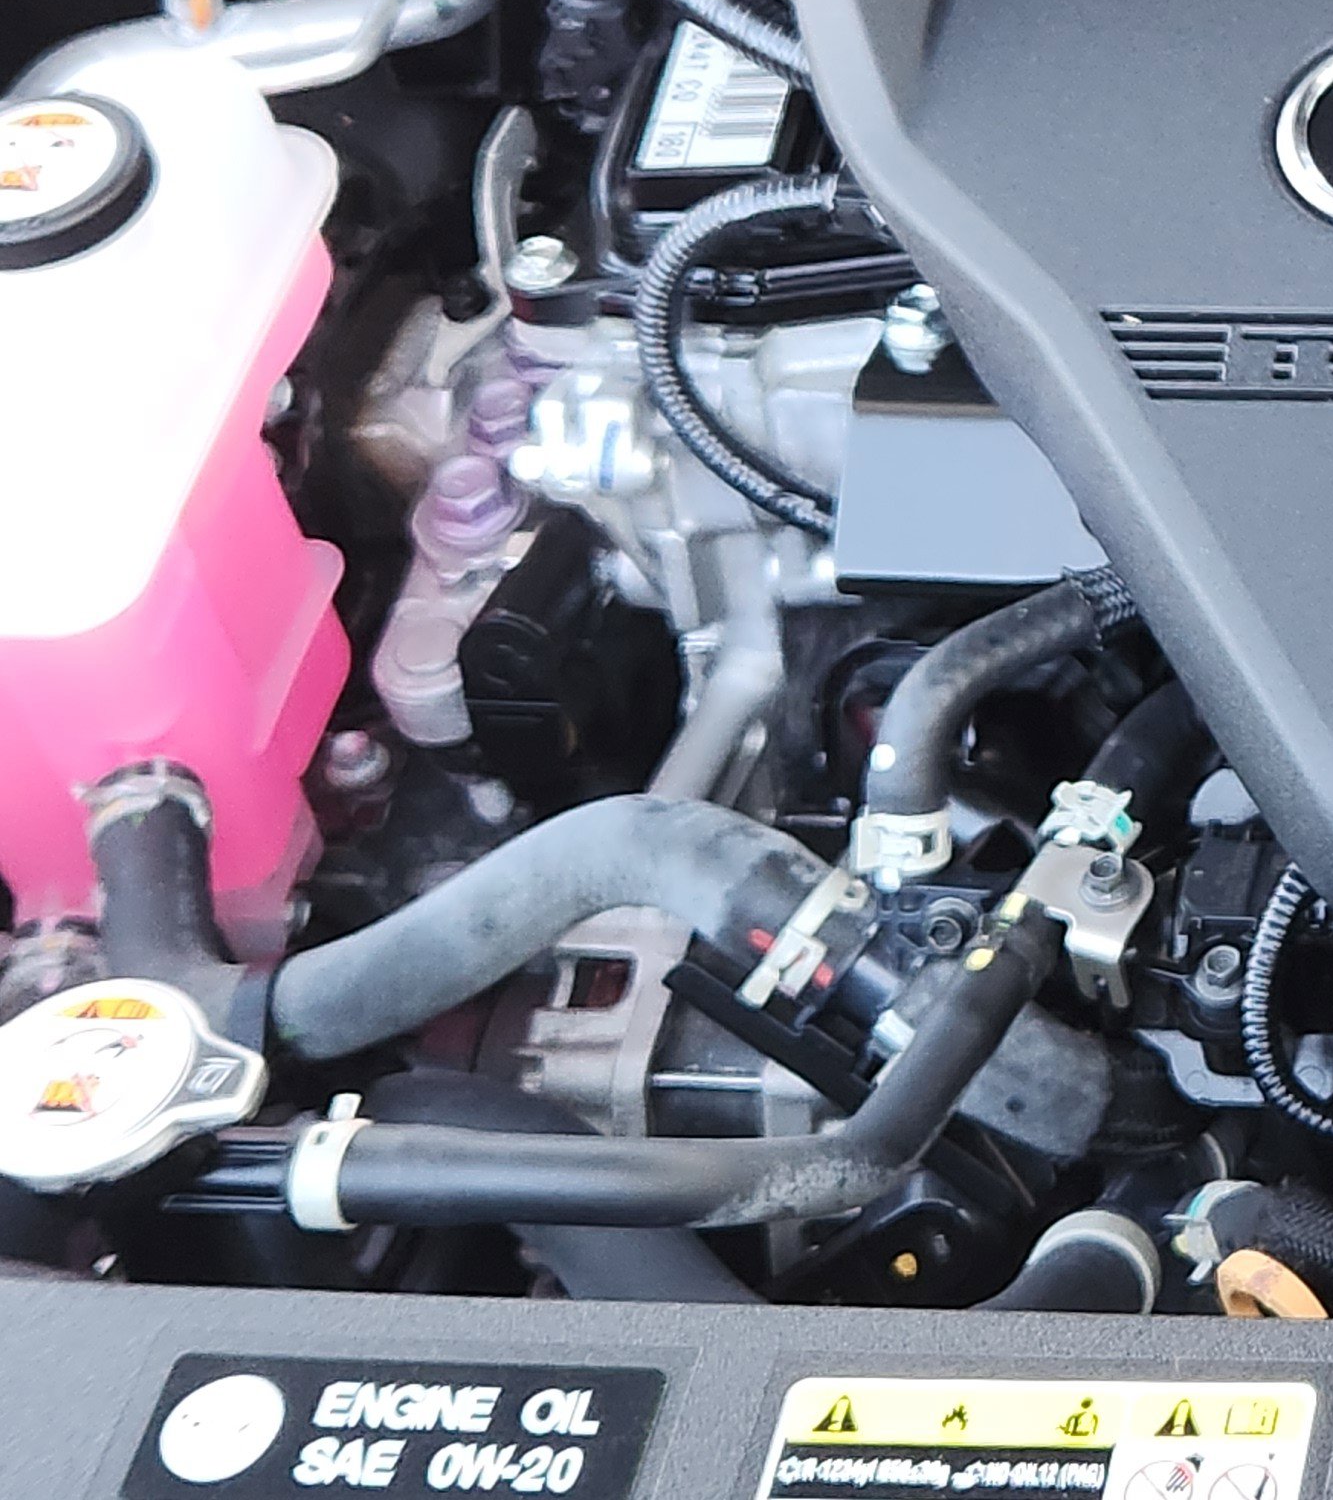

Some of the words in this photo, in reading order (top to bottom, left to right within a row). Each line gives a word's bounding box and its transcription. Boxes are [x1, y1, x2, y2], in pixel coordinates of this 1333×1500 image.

[312, 1380, 503, 1433] ENGINE
[520, 1388, 601, 1436] OIL
[292, 1437, 406, 1488] SAE
[426, 1443, 585, 1494] 0W-20
